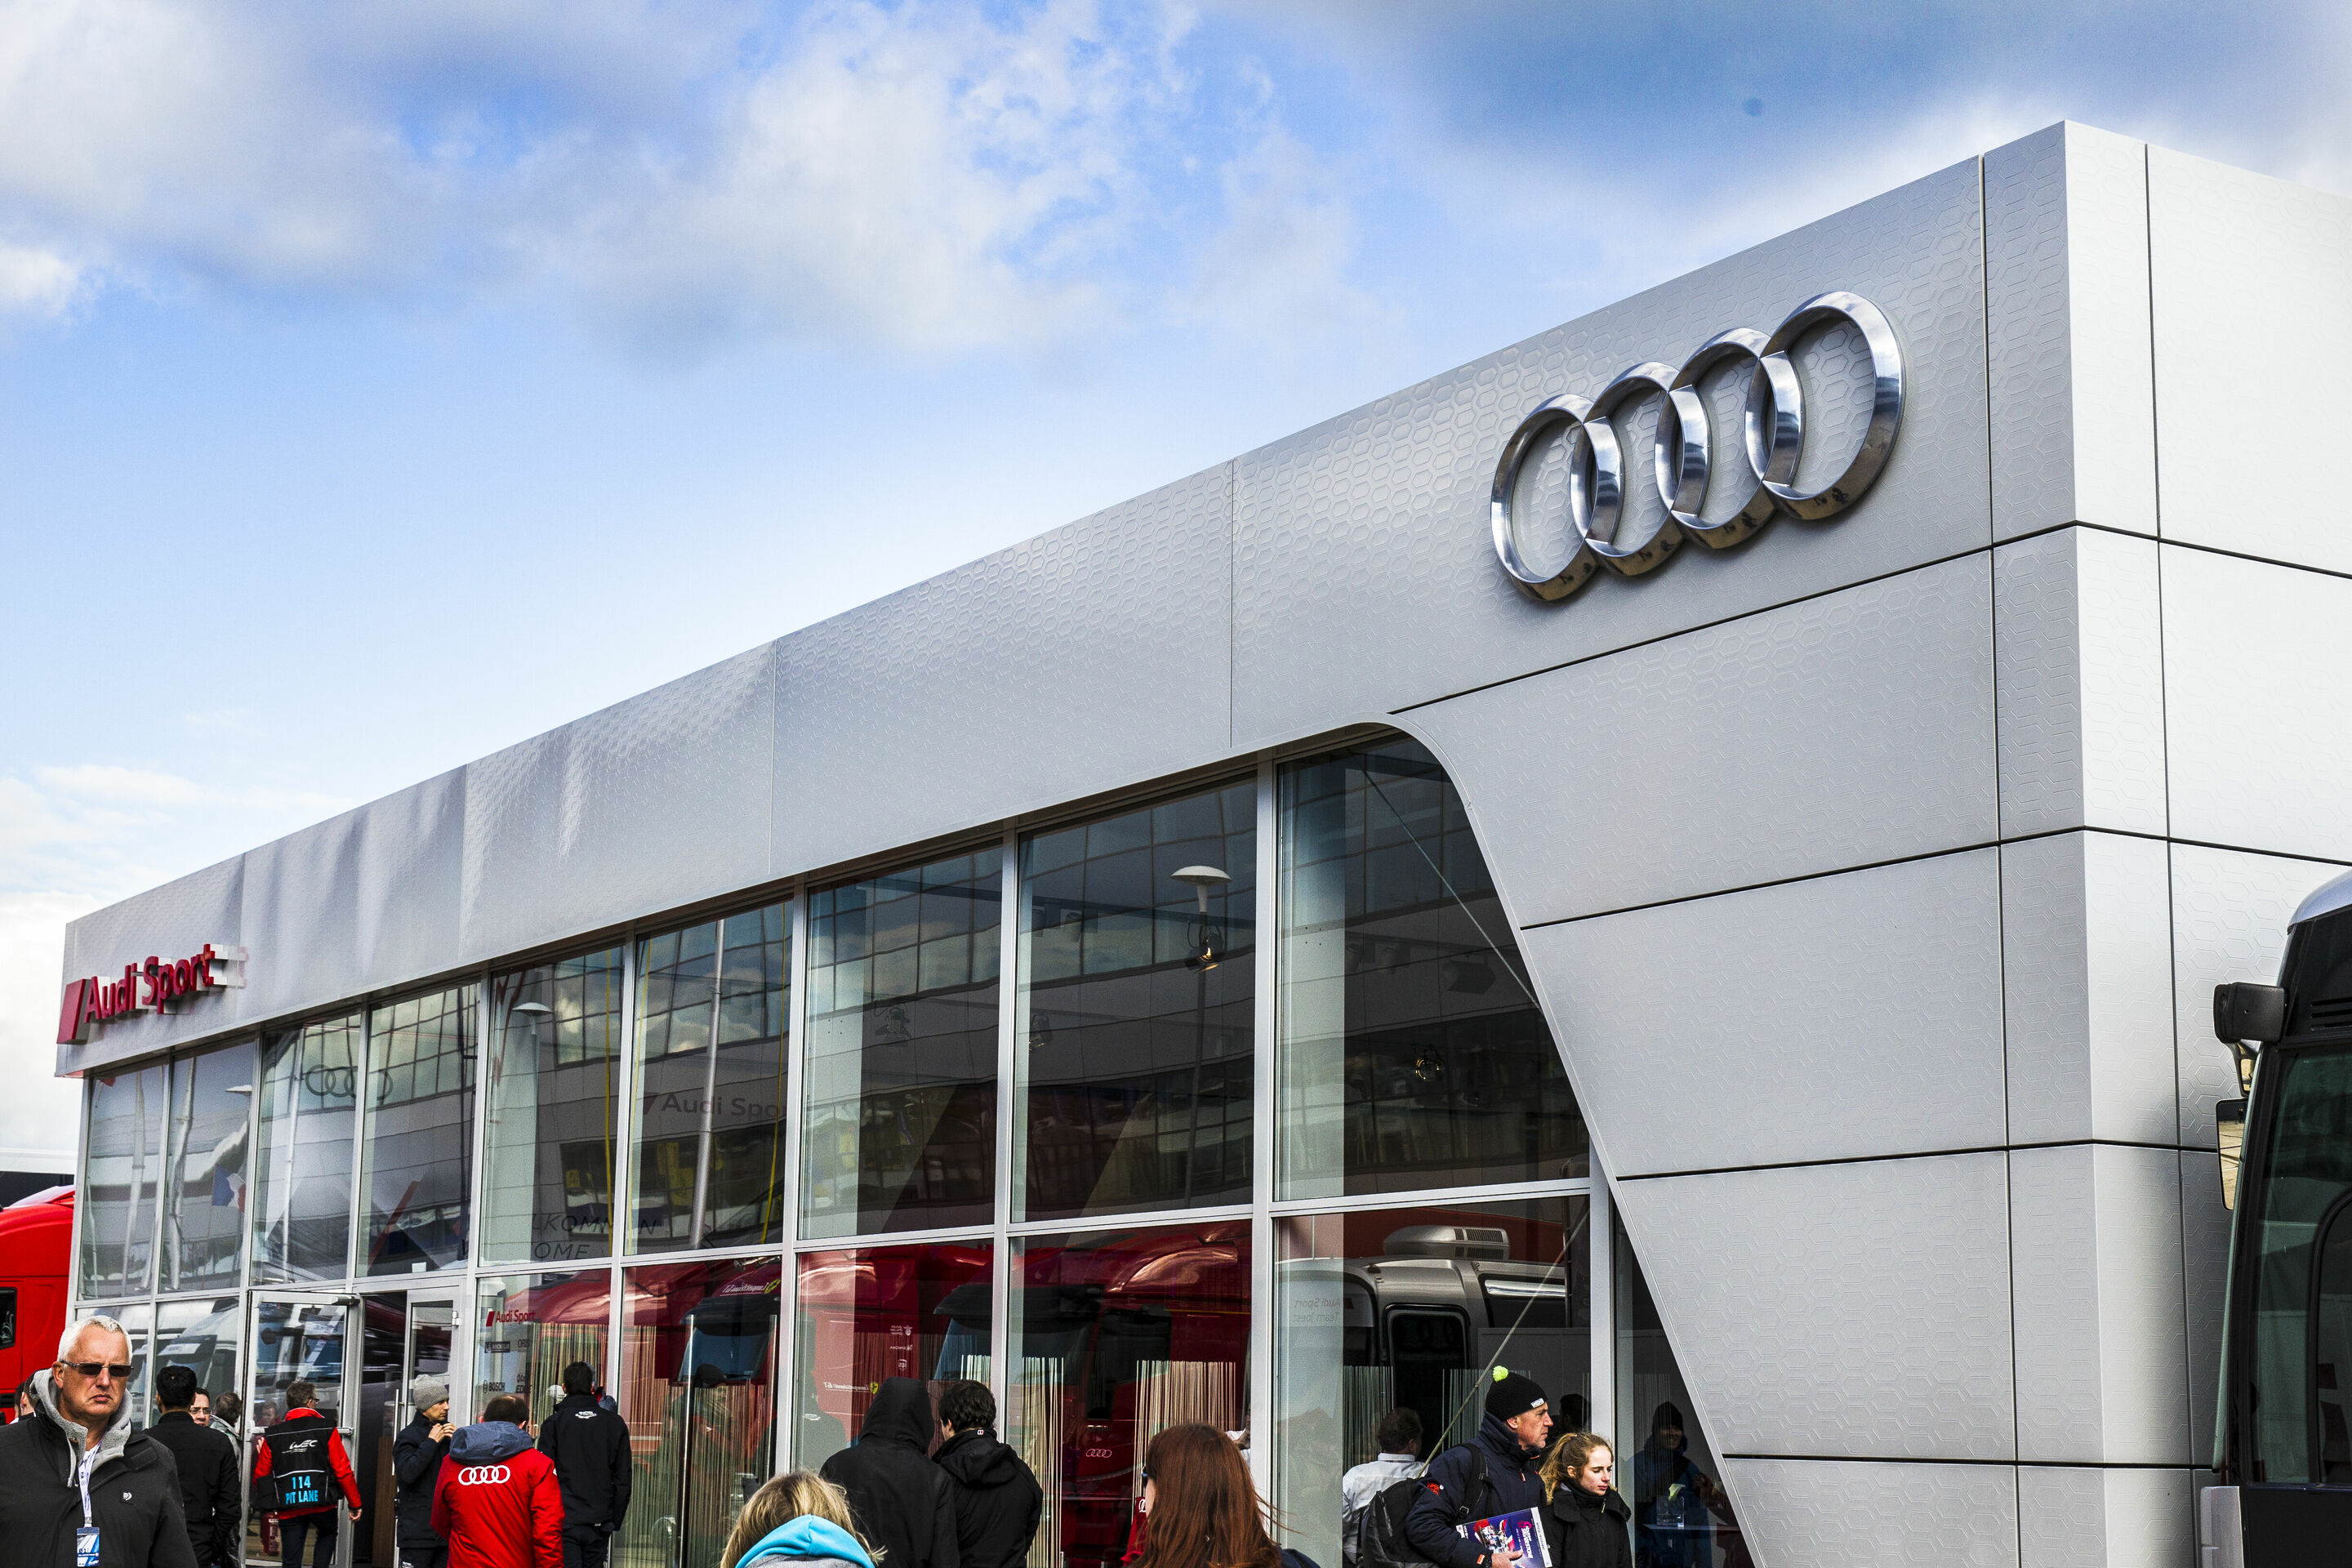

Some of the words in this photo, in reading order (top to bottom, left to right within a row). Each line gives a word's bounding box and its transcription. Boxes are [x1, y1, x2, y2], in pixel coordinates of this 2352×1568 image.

[84, 962, 137, 1023] Audi
[141, 943, 216, 1014] Sport
[661, 1092, 722, 1115] Audi
[731, 1097, 786, 1121] Spo
[496, 1311, 512, 1323] Audi
[514, 1310, 536, 1325] Sport
[488, 1382, 506, 1392] BOSCH
[289, 1440, 318, 1450] WEC
[292, 1476, 311, 1490] 114
[285, 1491, 296, 1504] PIT
[298, 1490, 318, 1503] LANE
